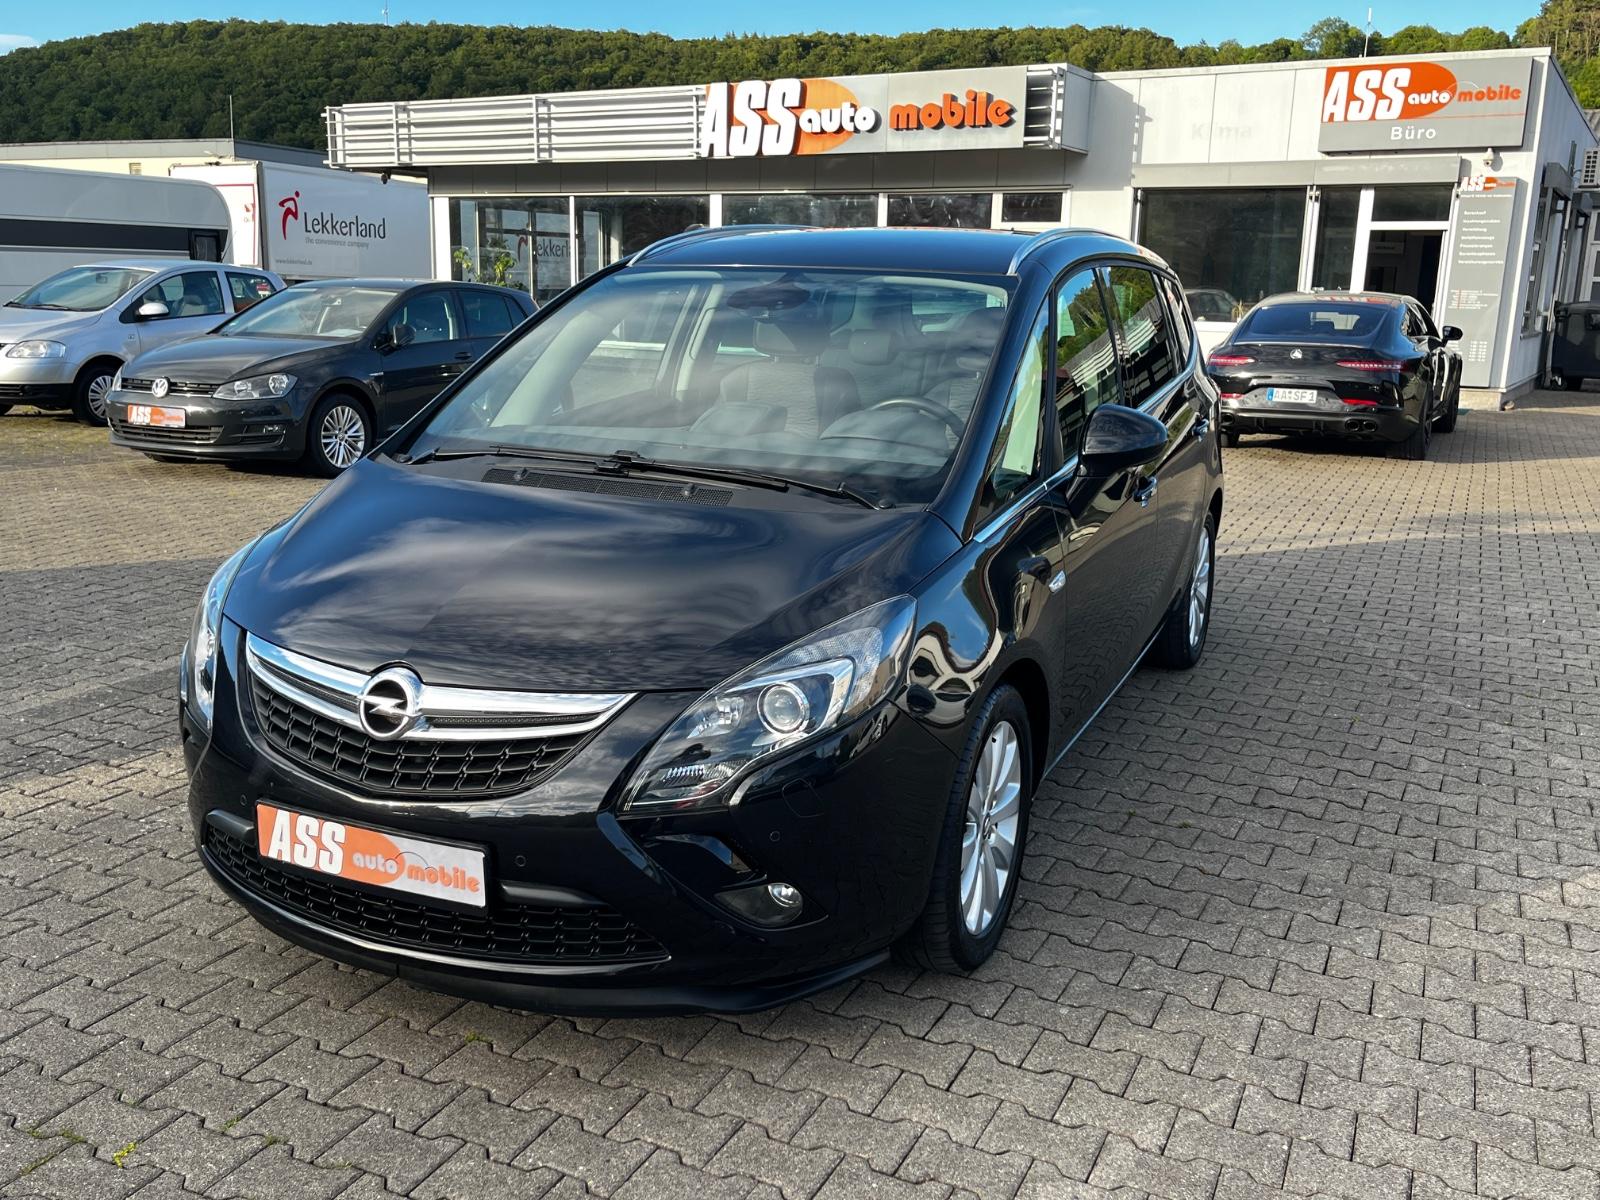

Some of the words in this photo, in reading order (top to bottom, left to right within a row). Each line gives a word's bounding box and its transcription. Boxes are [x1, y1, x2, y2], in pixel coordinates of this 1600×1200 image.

[1323, 68, 1411, 122] ASS
[1408, 90, 1450, 104] auto
[1458, 84, 1521, 102] mobile
[700, 78, 802, 157] ASS
[800, 102, 877, 133] auto
[889, 89, 1012, 129] mobile
[1192, 122, 1251, 140] Kima
[1391, 125, 1436, 140] Büro
[304, 212, 386, 239] Lekkerland
[268, 809, 346, 875] ASS
[352, 852, 398, 874] auto
[407, 864, 480, 893] mobile
